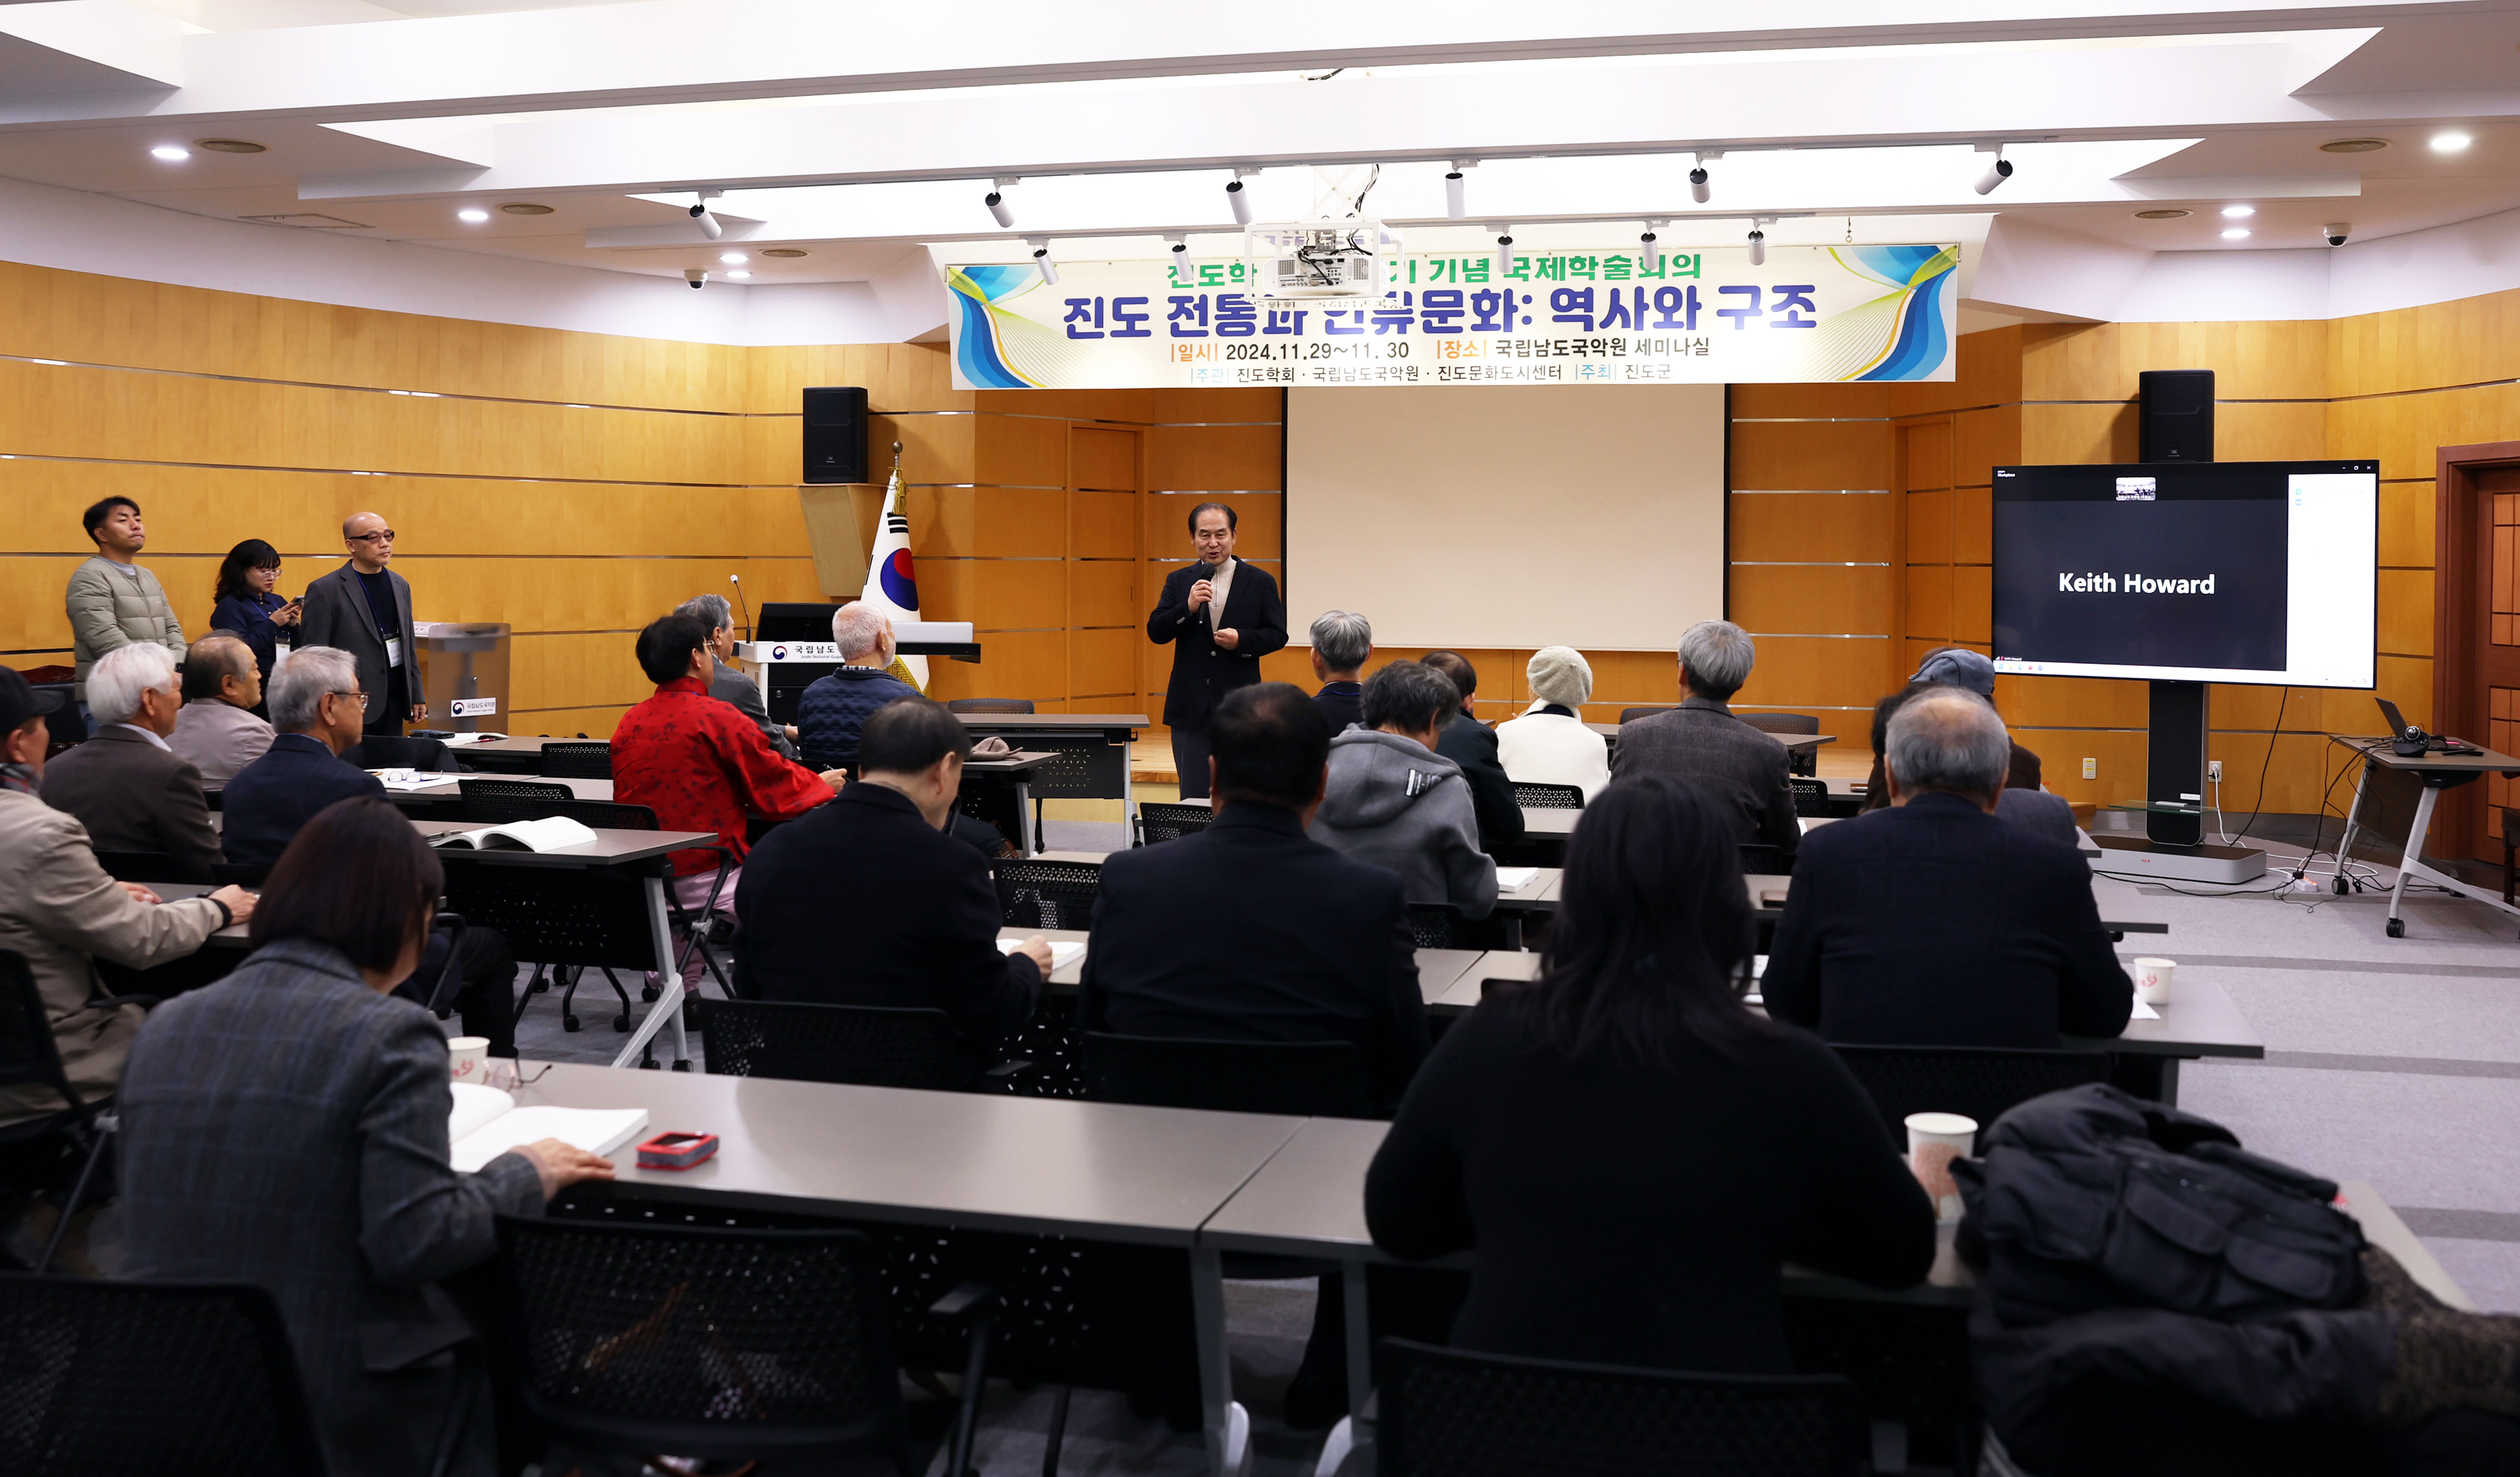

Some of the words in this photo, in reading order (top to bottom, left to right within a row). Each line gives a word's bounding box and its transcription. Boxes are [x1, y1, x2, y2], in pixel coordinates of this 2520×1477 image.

[1429, 258, 1489, 283] 기념
[1504, 254, 1701, 282] 국제학술회의
[1064, 296, 1152, 339] 진도
[1167, 294, 1309, 337] 전통과
[1550, 286, 1702, 332] 역사와
[1716, 285, 1817, 330] 구조
[1387, 341, 1409, 358] 30
[1496, 337, 1627, 358] 국립남도국악원
[1635, 337, 1709, 357] 세미나실
[1237, 367, 1294, 383] 진도학회
[1313, 365, 1419, 382] 국립남도국악원
[1437, 364, 1561, 381] 진도문화도시센터
[1625, 364, 1672, 380] 진도군
[2059, 572, 2116, 592] Keith
[2124, 573, 2215, 594] Howard
[795, 645, 839, 653] 국립남도
